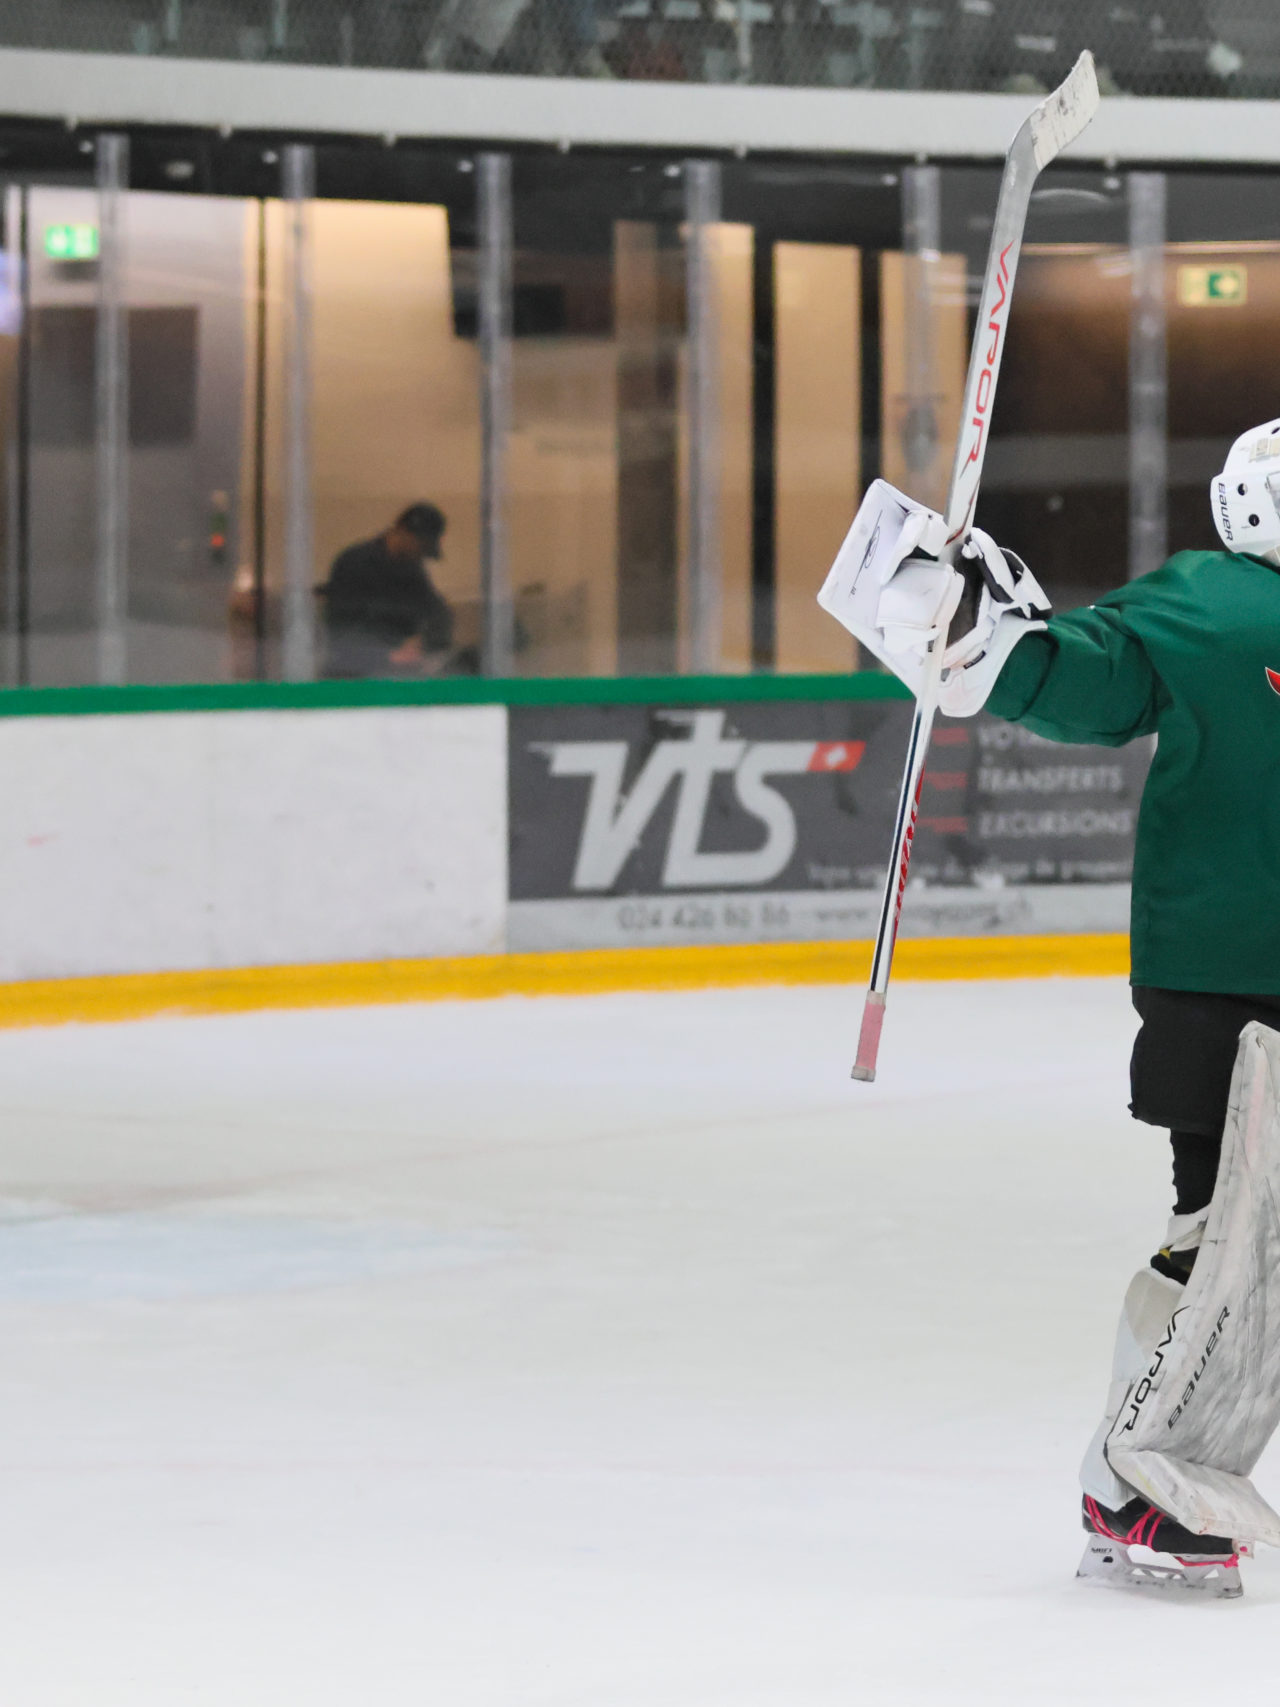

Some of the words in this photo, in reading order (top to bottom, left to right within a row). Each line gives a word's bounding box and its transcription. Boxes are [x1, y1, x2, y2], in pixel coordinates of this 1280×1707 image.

[959, 239, 1015, 479] VAPOR
[1217, 482, 1234, 541] BAUER
[1117, 1305, 1191, 1437] VAPOR
[1167, 1306, 1231, 1429] BAUER
